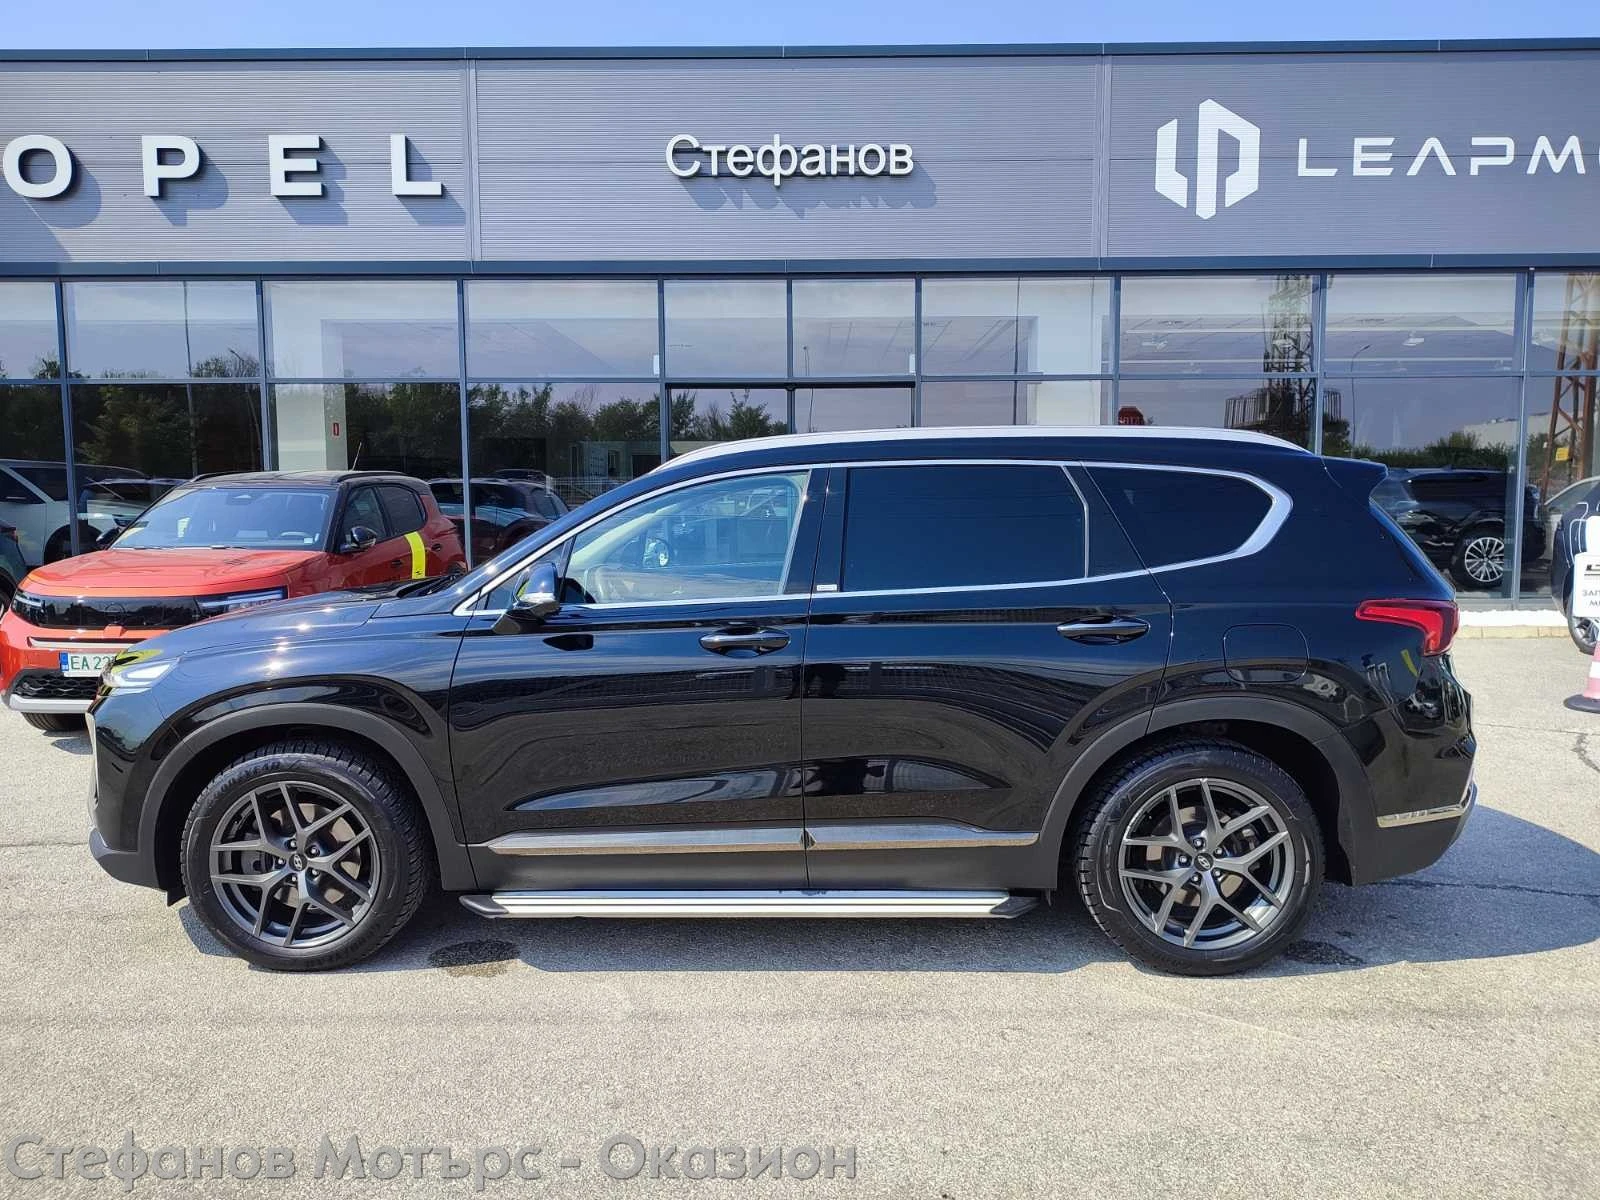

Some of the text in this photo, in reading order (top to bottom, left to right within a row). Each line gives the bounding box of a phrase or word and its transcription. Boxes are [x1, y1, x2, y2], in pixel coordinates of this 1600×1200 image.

[2, 134, 443, 198] OPEL
[665, 133, 915, 187] Стефанов
[1297, 135, 1600, 177] LEAPM
